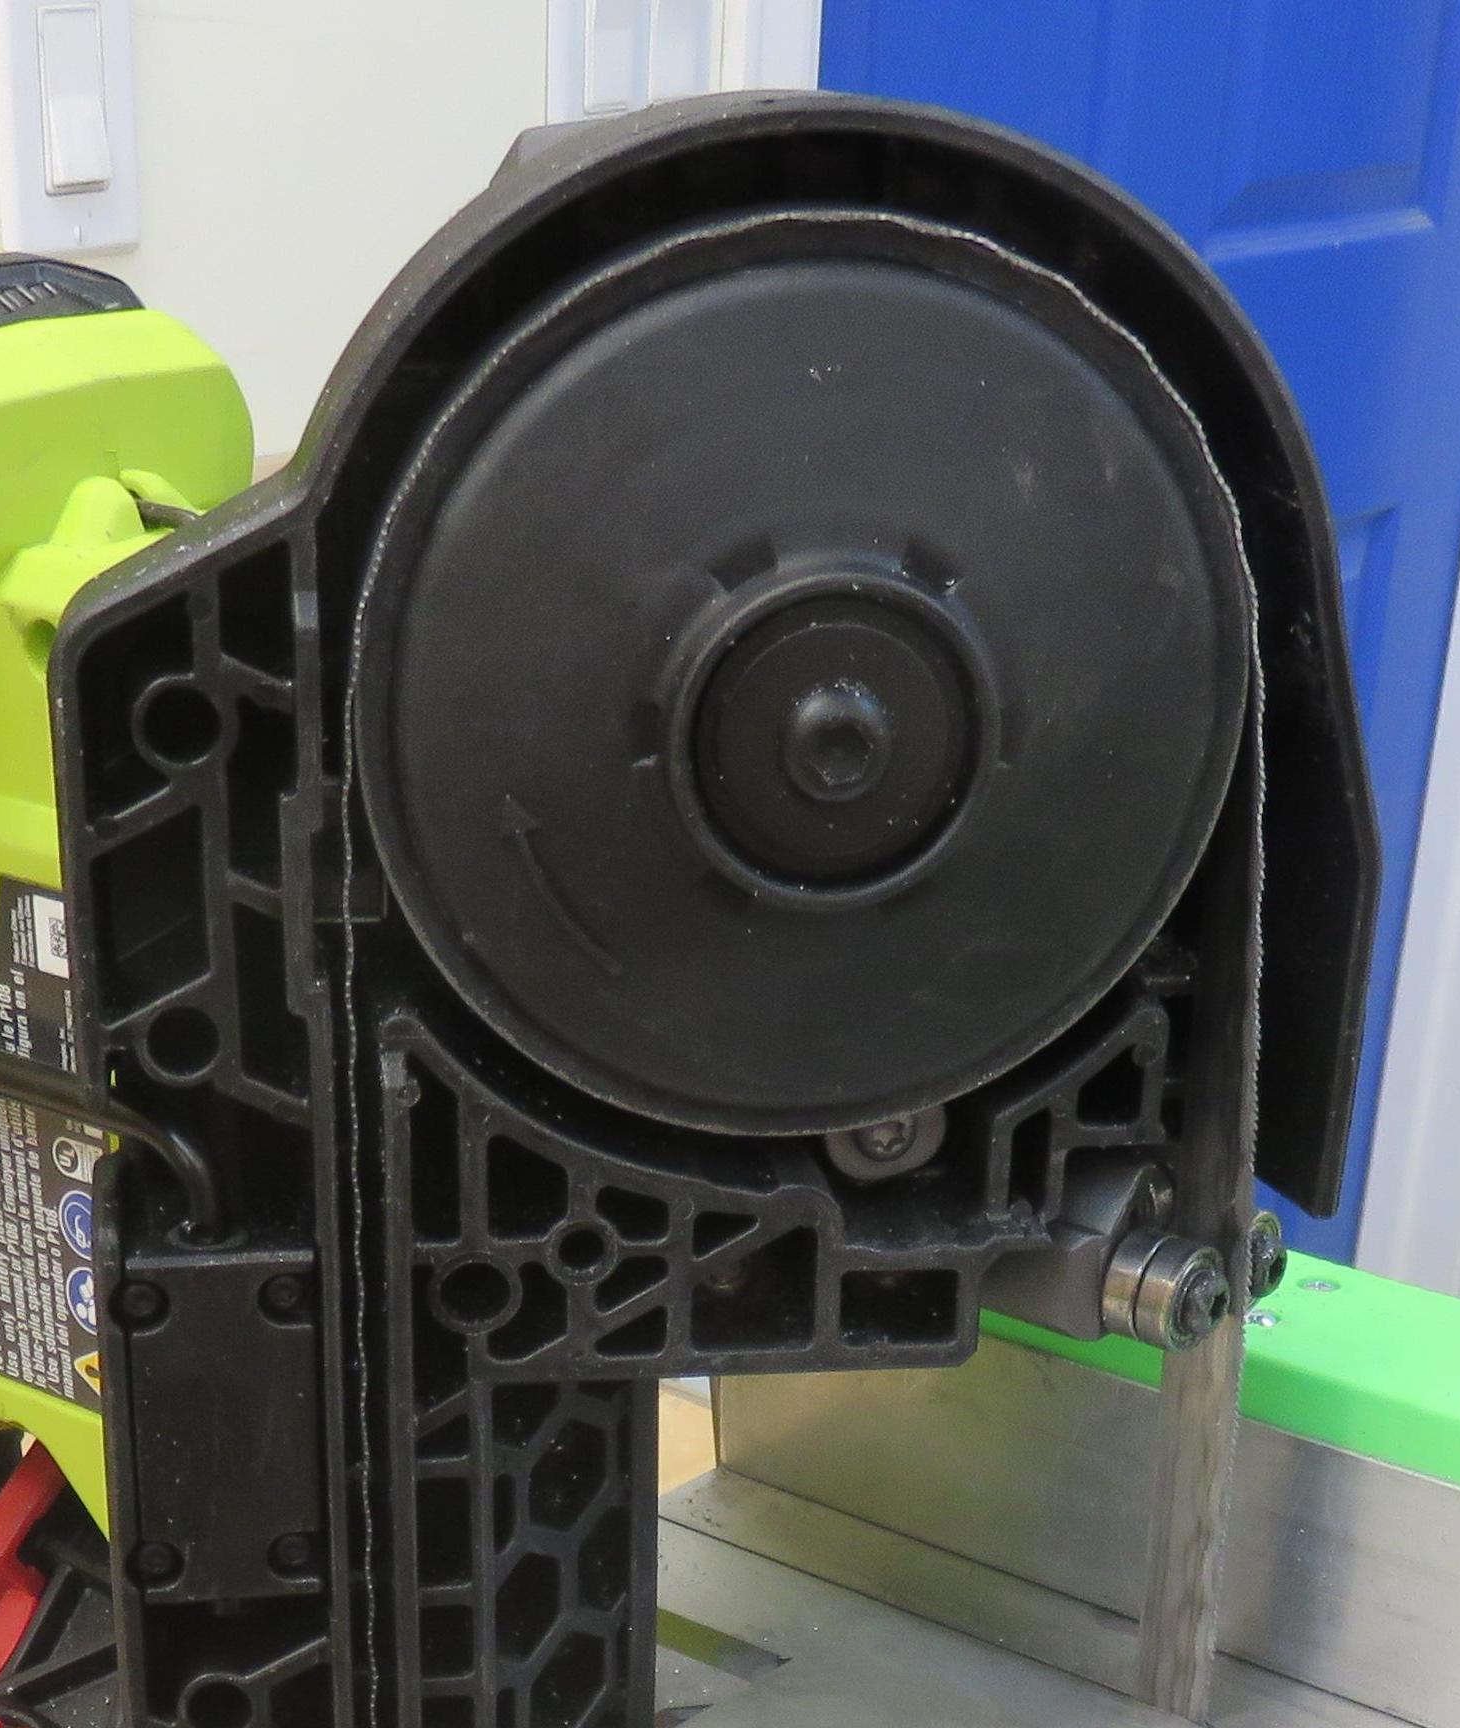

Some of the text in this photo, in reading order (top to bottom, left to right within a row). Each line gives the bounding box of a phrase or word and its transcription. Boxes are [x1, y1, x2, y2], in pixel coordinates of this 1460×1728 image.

[11, 968, 23, 985] el
[15, 990, 26, 1009] en
[1, 1024, 12, 1040] le
[17, 1015, 31, 1059] figura
[28, 1151, 39, 1169] de
[58, 1149, 75, 1167] UL
[2, 1153, 16, 1214] Employer
[14, 1150, 28, 1204] manuel
[19, 1206, 30, 1220] le
[31, 1174, 46, 1231] paquete
[6, 1224, 19, 1256] P108
[21, 1222, 33, 1256] dans
[36, 1232, 46, 1248] el
[52, 1248, 60, 1256] o
[11, 1260, 21, 1271] or
[38, 1254, 49, 1279] con
[11, 1274, 27, 1320] manual
[52, 1259, 68, 1321] operador
[4, 1311, 16, 1342] only
[39, 1283, 56, 1354] solamente
[30, 1312, 45, 1373] bloc-pile
[57, 1323, 68, 1346] del
[7, 1350, 18, 1377] Use
[17, 1321, 33, 1383] operator's
[38, 1374, 47, 1388] le
[48, 1358, 59, 1383] Use
[60, 1349, 75, 1399] manual
